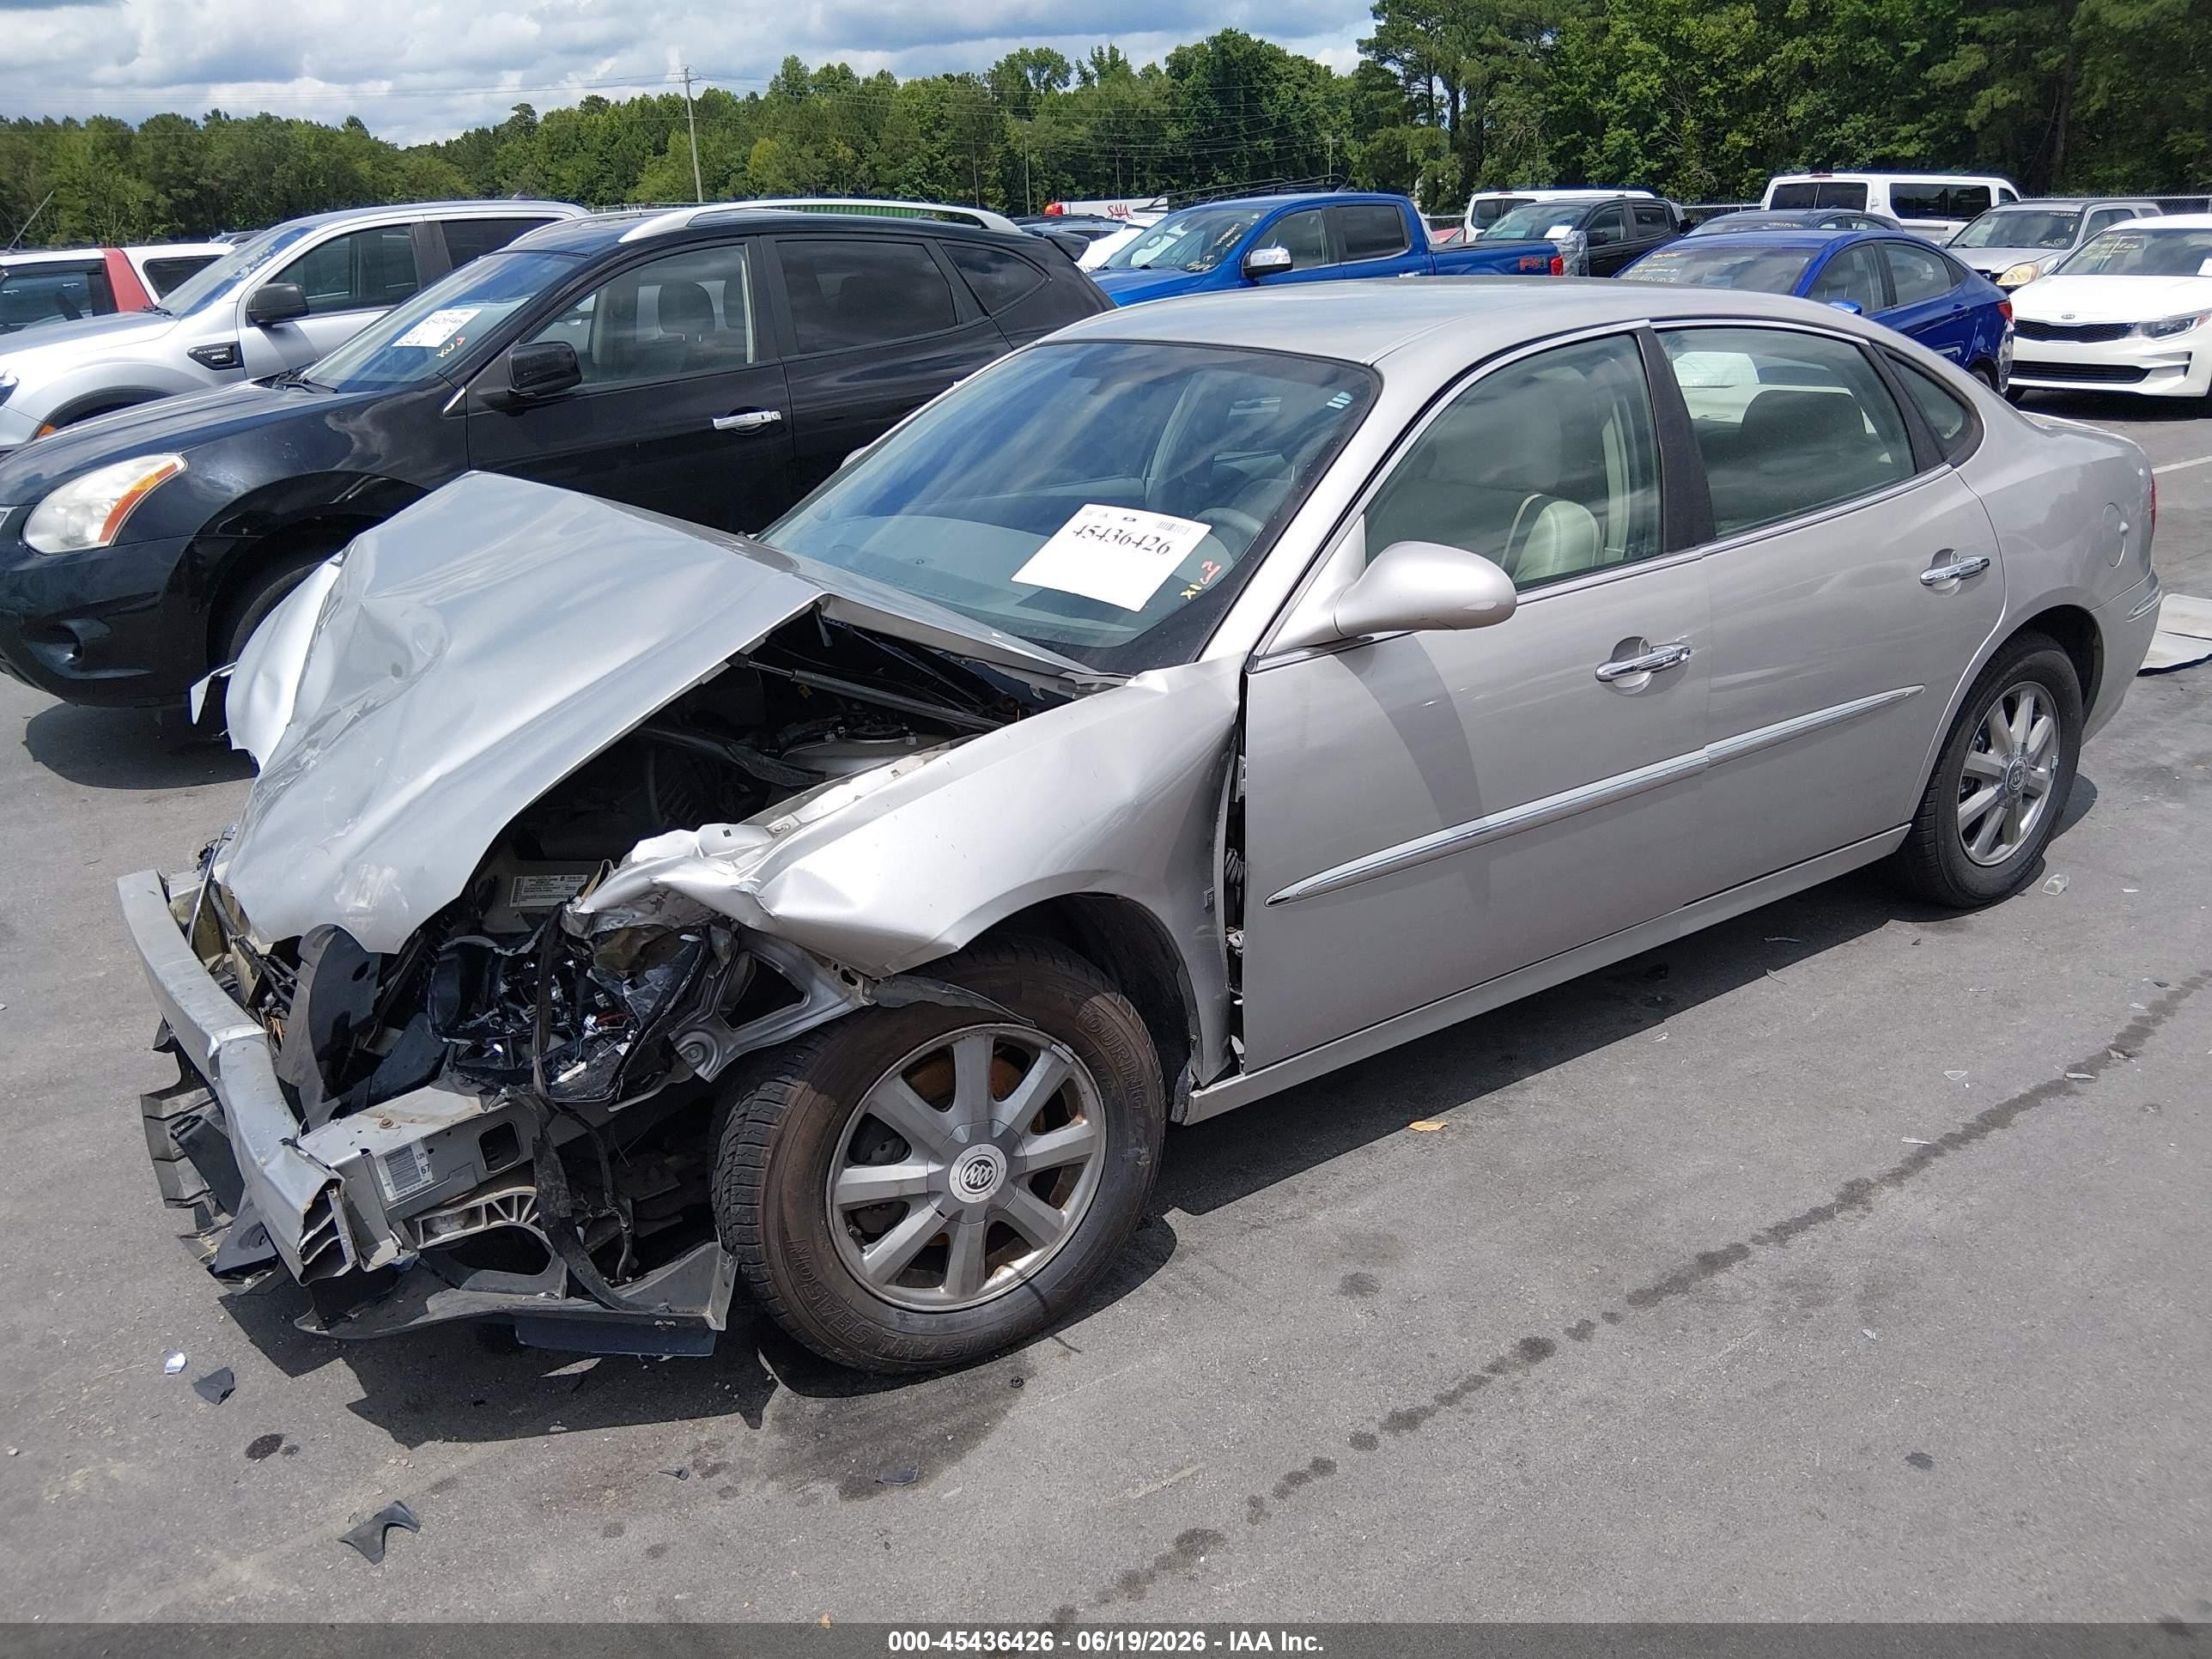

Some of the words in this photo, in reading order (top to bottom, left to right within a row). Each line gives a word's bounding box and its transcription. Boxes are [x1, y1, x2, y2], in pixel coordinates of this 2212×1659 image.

[1107, 203, 1133, 219] SAIA
[1519, 256, 1548, 271] FX4
[1073, 524, 1171, 556] 45436426
[783, 1237, 874, 1346] SEASON
